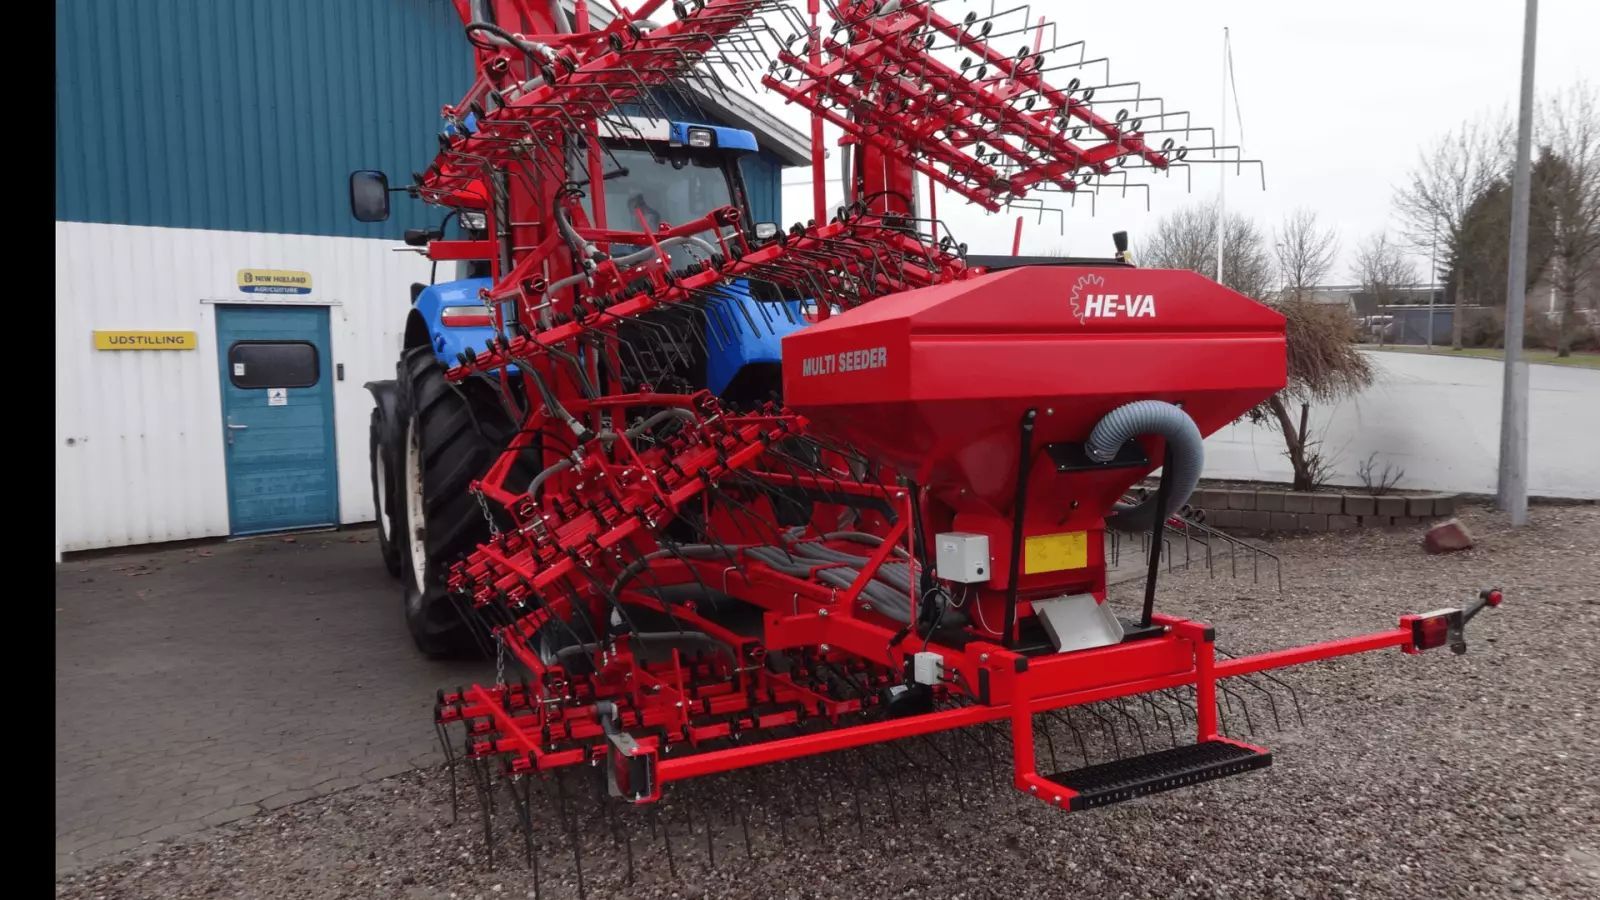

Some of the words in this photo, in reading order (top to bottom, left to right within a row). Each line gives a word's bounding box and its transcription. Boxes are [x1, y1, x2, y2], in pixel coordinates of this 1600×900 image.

[1084, 294, 1156, 318] HE-VA
[108, 335, 185, 345] UDSTILLING
[802, 354, 836, 377] MULTI
[838, 346, 887, 373] SEEDER
